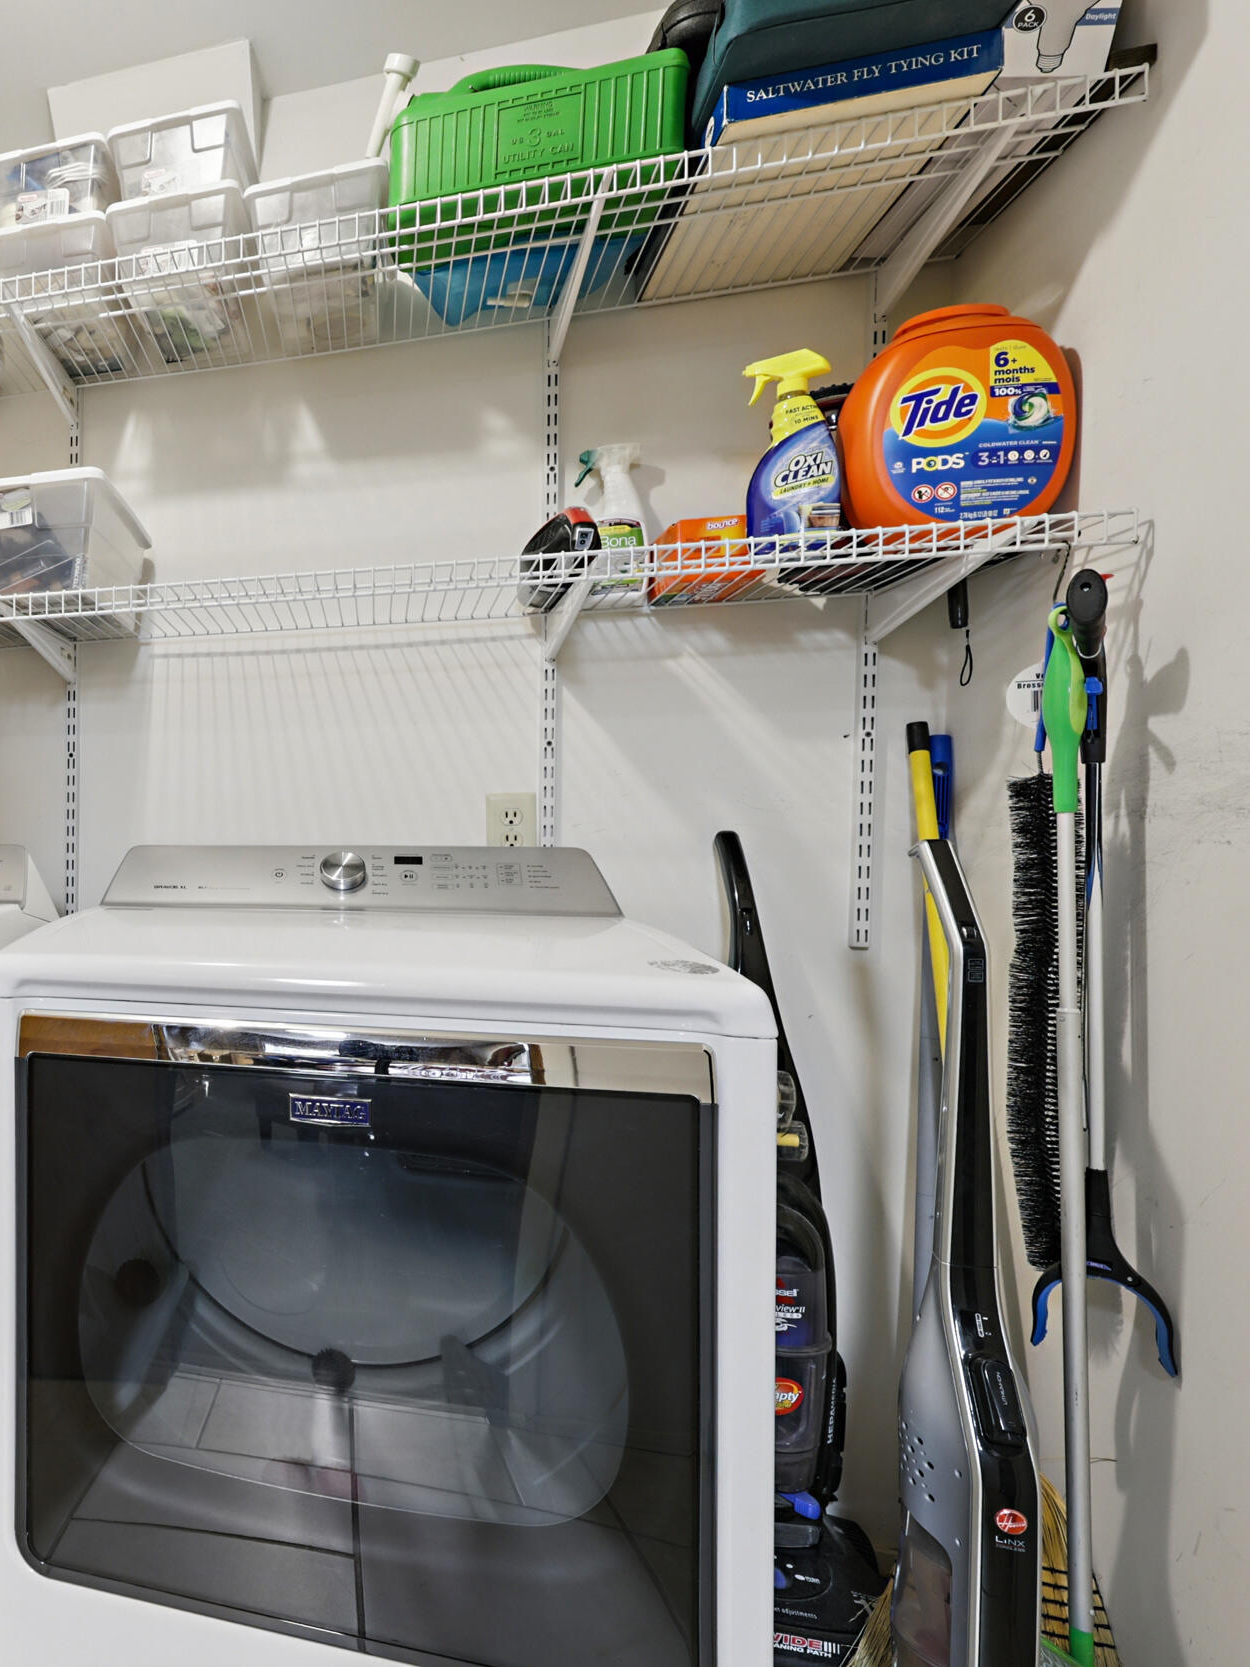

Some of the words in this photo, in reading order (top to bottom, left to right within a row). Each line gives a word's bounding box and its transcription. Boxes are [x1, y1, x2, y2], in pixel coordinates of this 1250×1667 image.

[1024, 9, 1036, 21] 6
[746, 72, 848, 103] SALTWATER
[853, 64, 882, 81] FLY
[887, 53, 945, 74] TYING
[950, 44, 981, 62] KIT
[503, 148, 545, 164] UTILITY
[550, 143, 574, 155] CAN
[994, 366, 1035, 376] months
[994, 376, 1021, 384] mois
[994, 387, 1022, 396] 100%
[900, 384, 980, 440] Tide
[978, 440, 1017, 449] COLDWATER
[788, 451, 823, 472] OXI
[911, 453, 966, 473] PODS
[774, 460, 833, 488] CLEAN
[780, 483, 806, 494] LAUNDRY
[706, 518, 739, 531] bounce
[600, 535, 637, 548] Bona
[293, 1101, 367, 1119] MAYTAG
[775, 1305, 797, 1313] view
[806, 1648, 831, 1658] PATH
